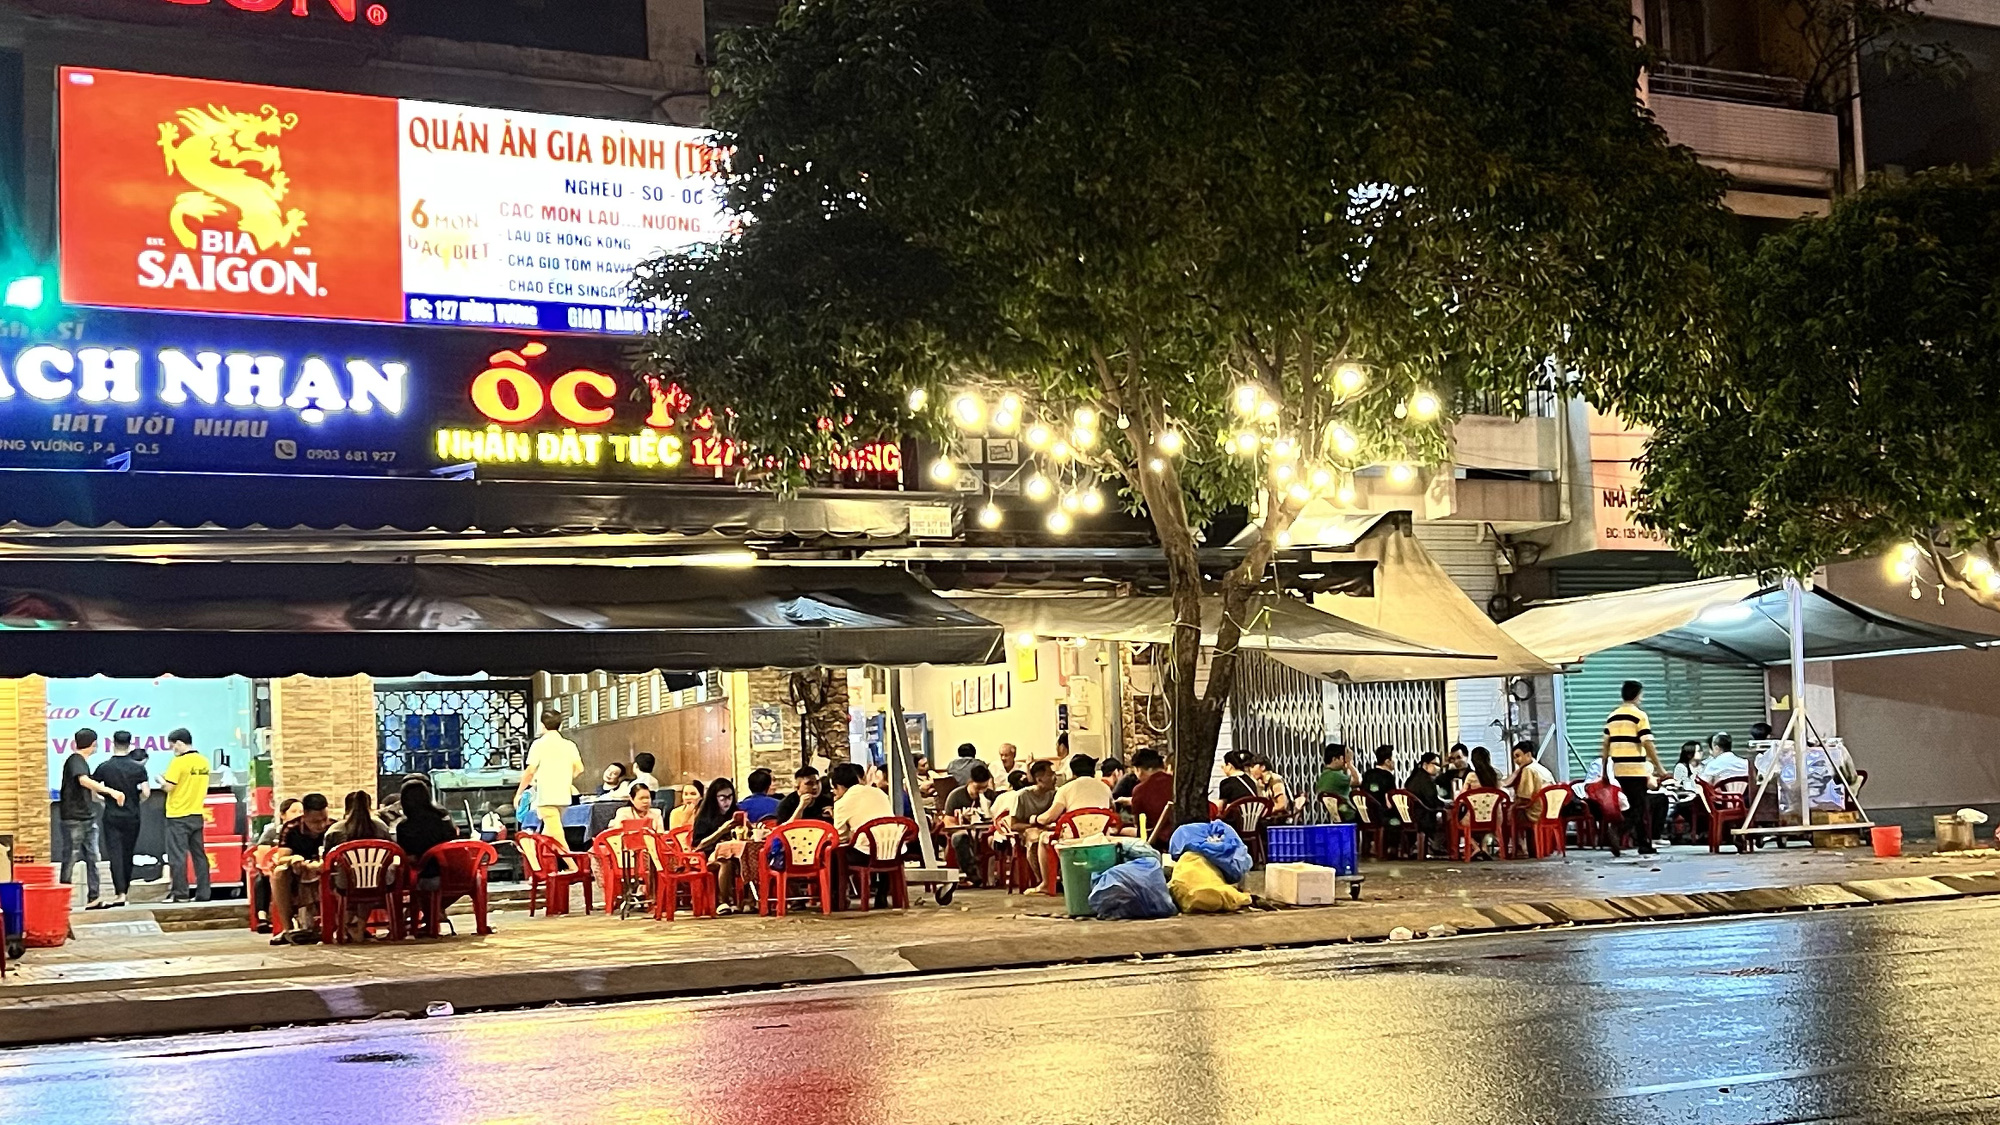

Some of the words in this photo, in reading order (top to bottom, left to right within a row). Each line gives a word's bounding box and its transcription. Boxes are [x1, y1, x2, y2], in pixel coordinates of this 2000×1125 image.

[409, 113, 489, 153] QUÁN
[499, 118, 537, 158] ĂN
[547, 129, 593, 163] GIA
[602, 129, 665, 170] ĐÌNH
[411, 198, 429, 228] 6
[201, 229, 258, 255] BIA
[0, 345, 140, 403] CH
[157, 350, 408, 424] NHẠN
[470, 342, 617, 425] ỐC
[194, 418, 268, 438] NHAU
[31, 438, 85, 452] VƯƠNG
[306, 448, 340, 461] 0903
[345, 450, 368, 462] 681
[372, 451, 397, 463] 927
[1603, 485, 1627, 508] NHÀ
[1623, 528, 1636, 539] 135
[90, 698, 151, 722] Lưu
